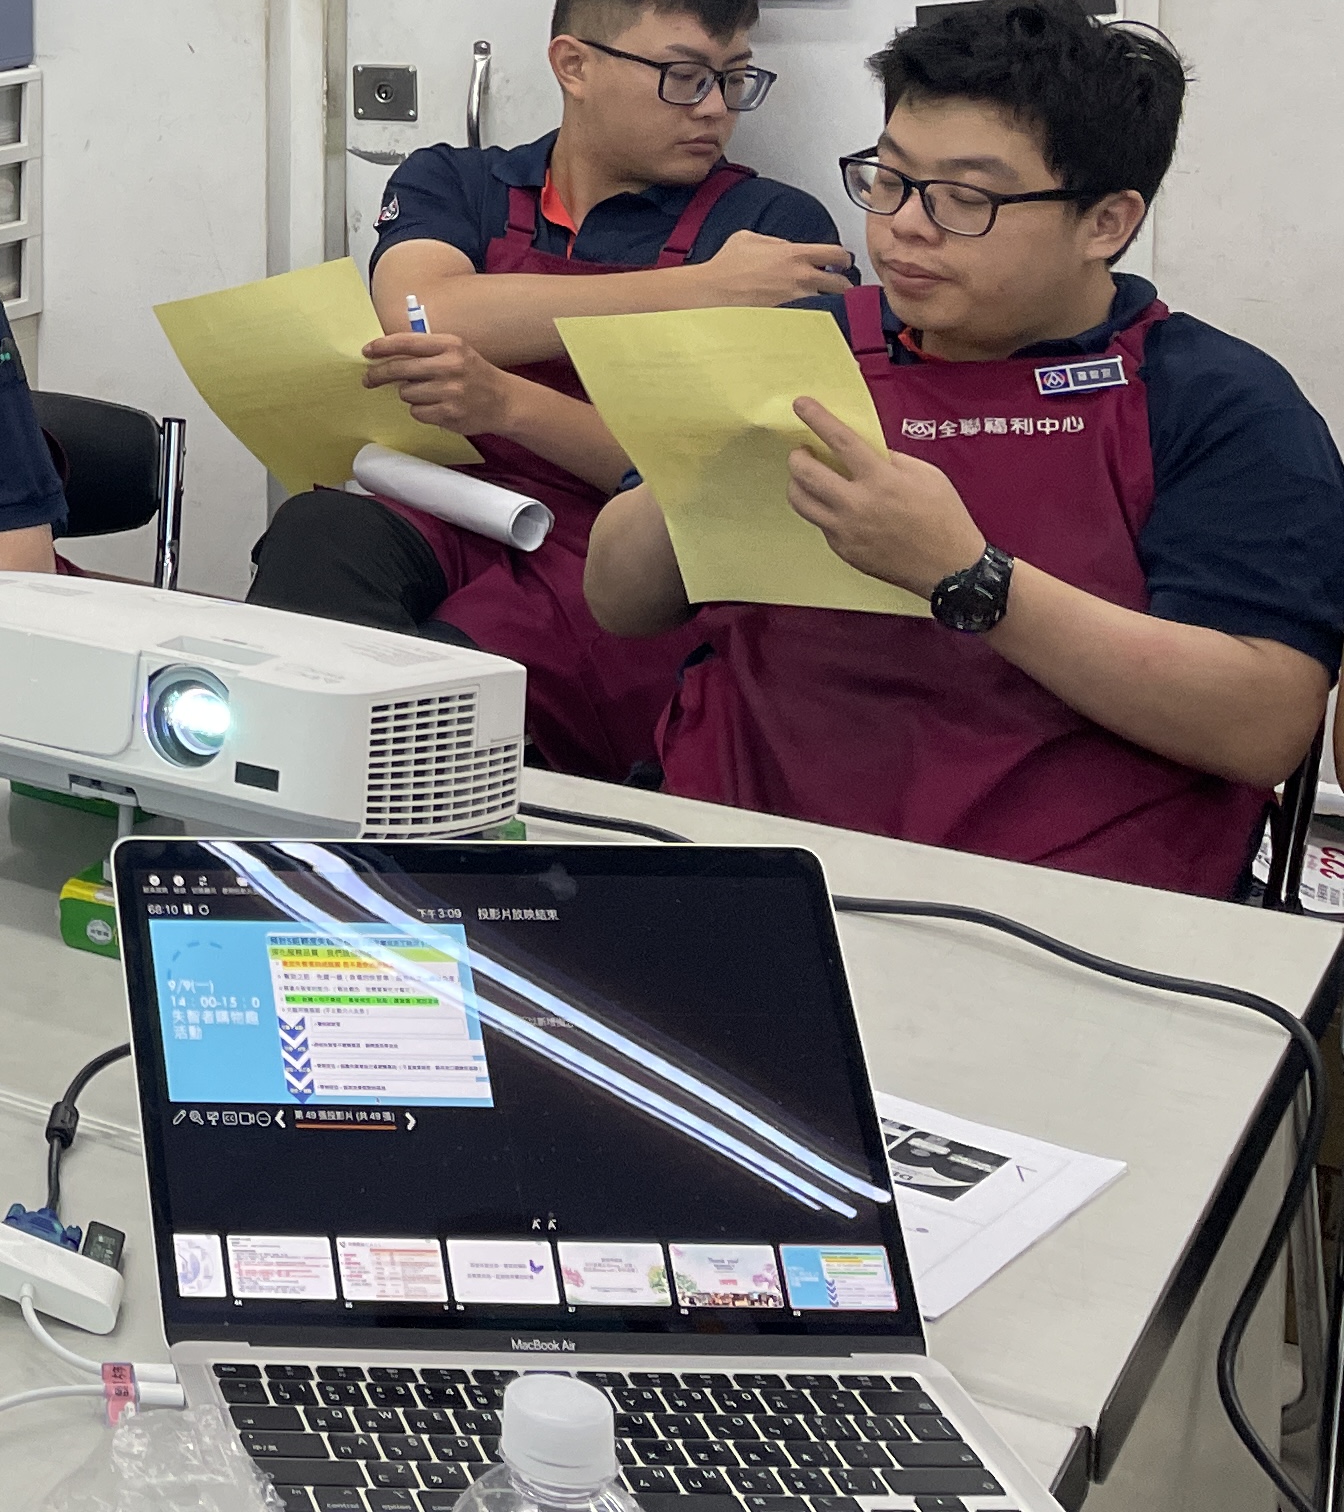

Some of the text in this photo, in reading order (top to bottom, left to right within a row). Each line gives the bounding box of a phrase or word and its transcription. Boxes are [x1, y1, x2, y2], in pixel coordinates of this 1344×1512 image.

[938, 416, 1085, 438] 全聯福利中心
[511, 1338, 577, 1353] MacBook Air
